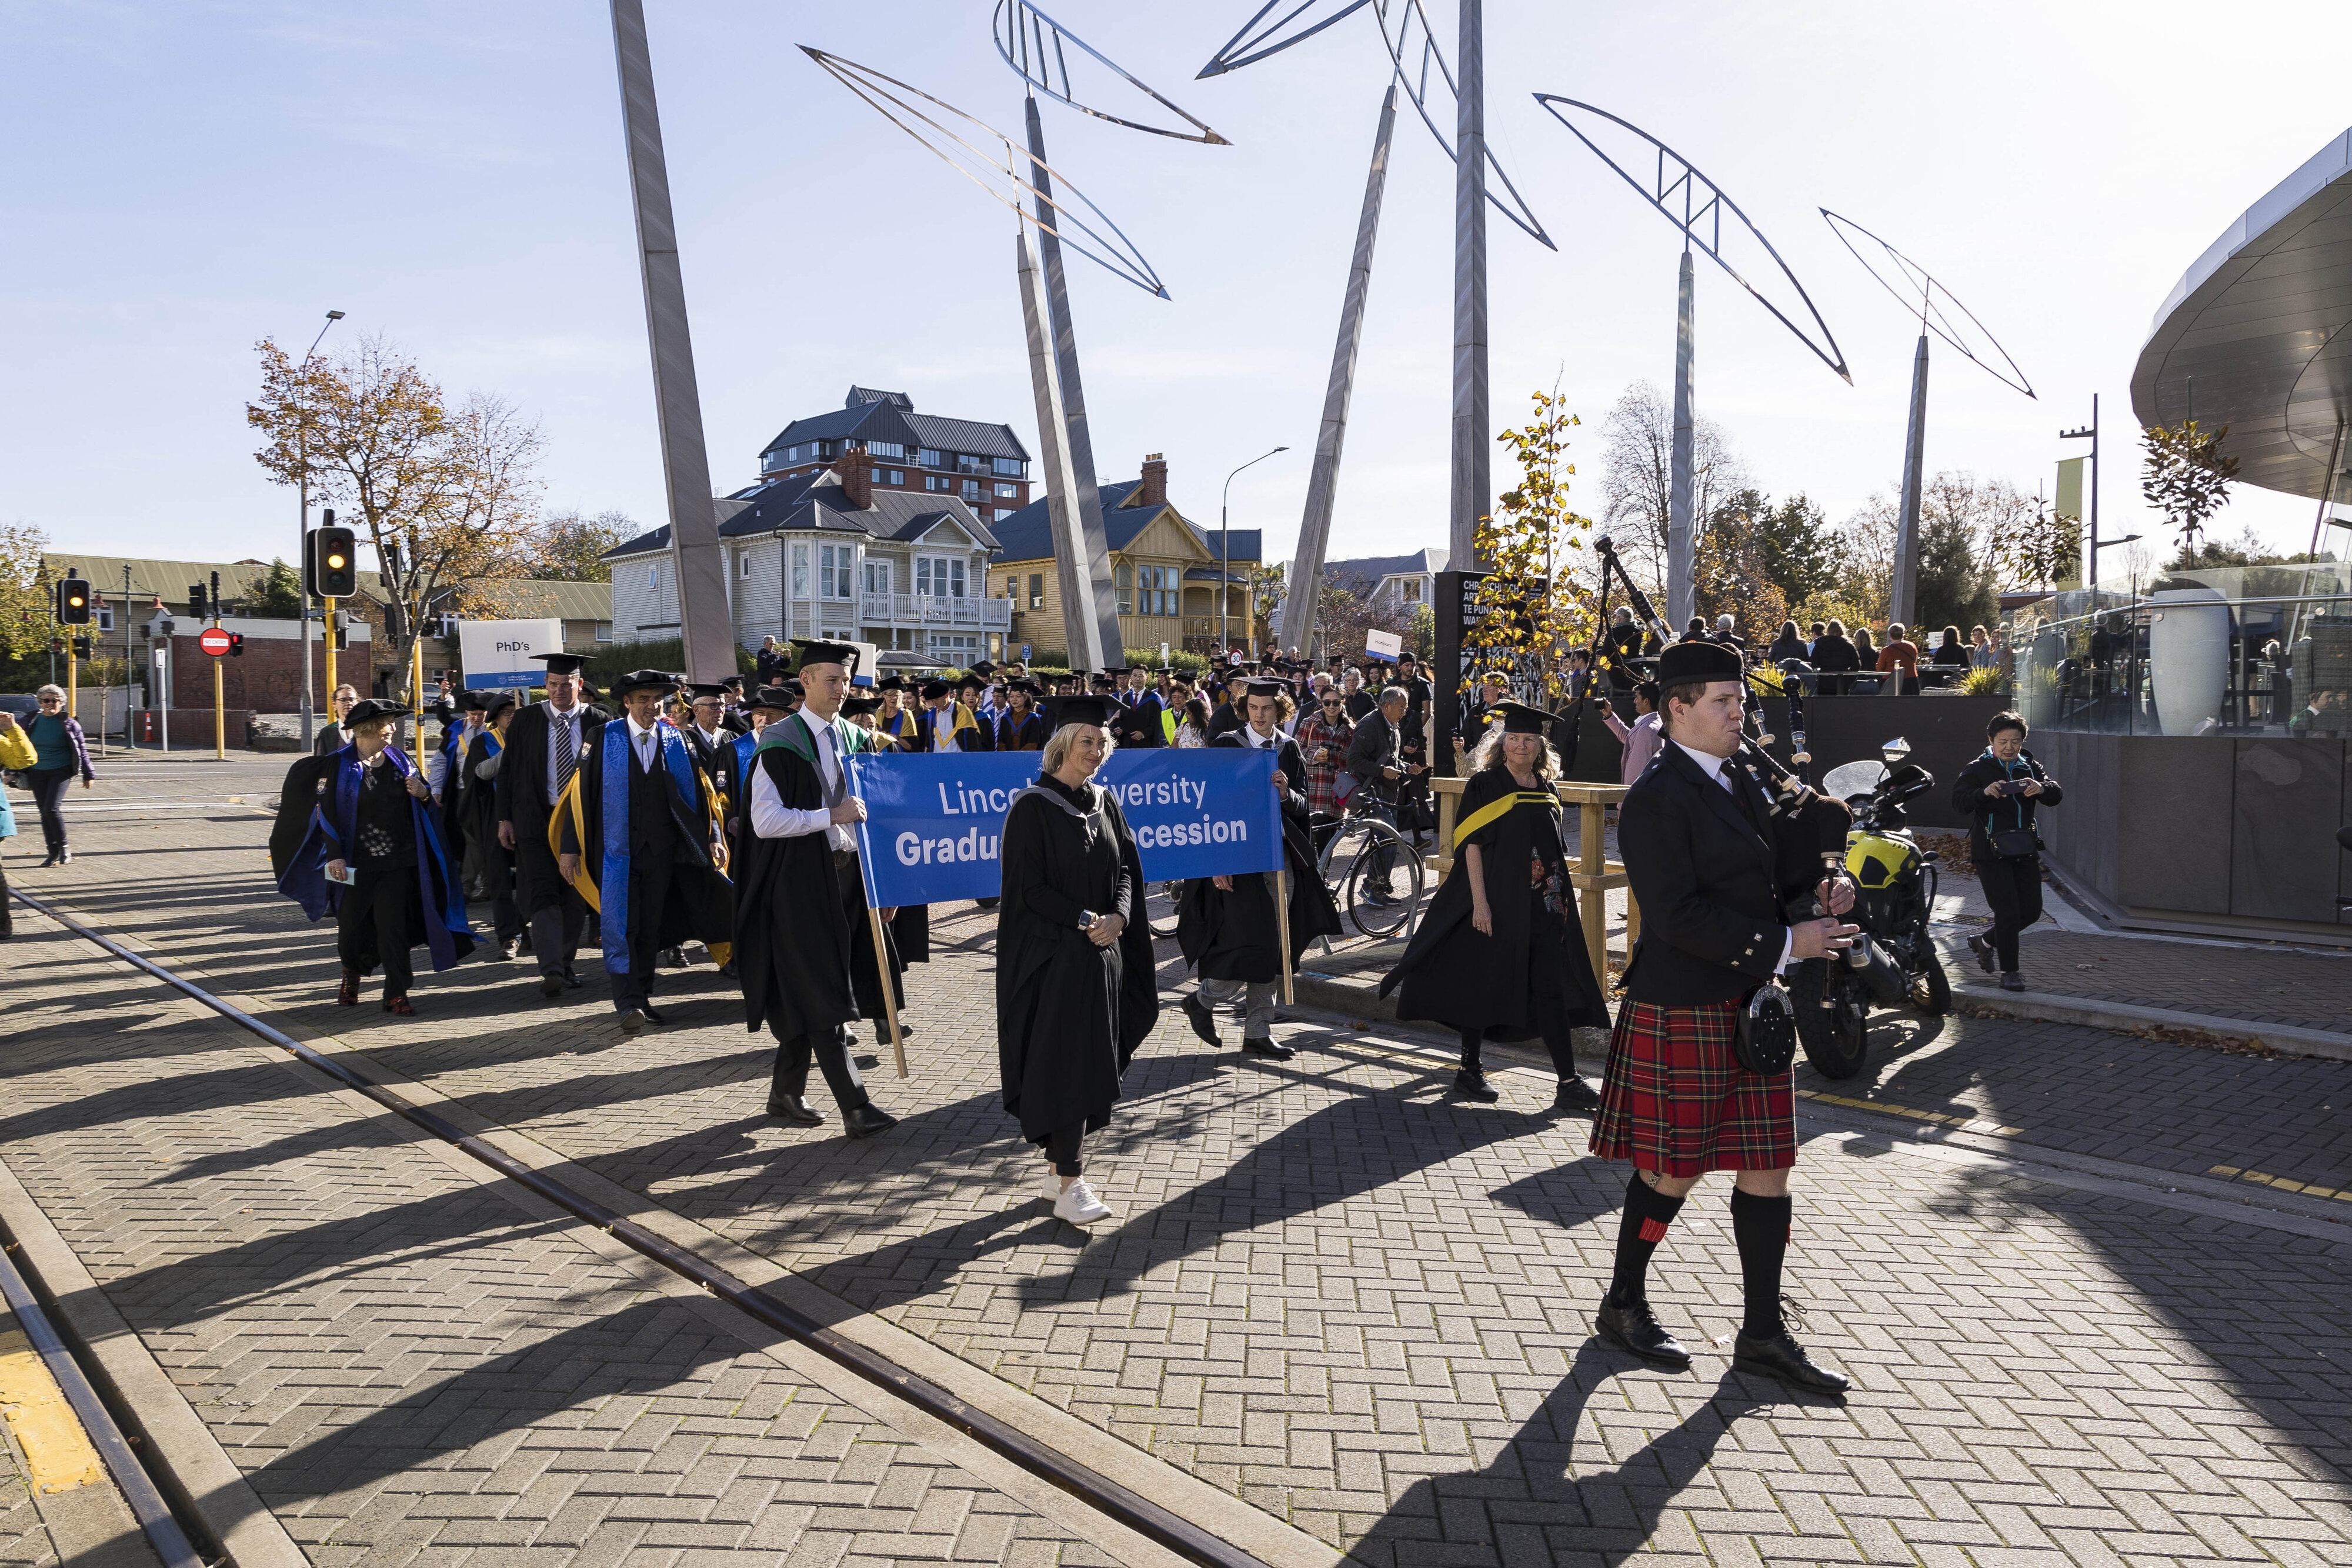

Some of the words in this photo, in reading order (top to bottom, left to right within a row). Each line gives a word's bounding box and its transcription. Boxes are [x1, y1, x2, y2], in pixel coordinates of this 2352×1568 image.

[1463, 581, 1519, 593] CHRCHCH
[1463, 604, 1473, 613] TE
[496, 641, 530, 652] PhD's
[939, 778, 1032, 814] Linco
[1103, 773, 1206, 809] versity
[896, 827, 1002, 866] Gradu
[1129, 814, 1247, 848] cession
